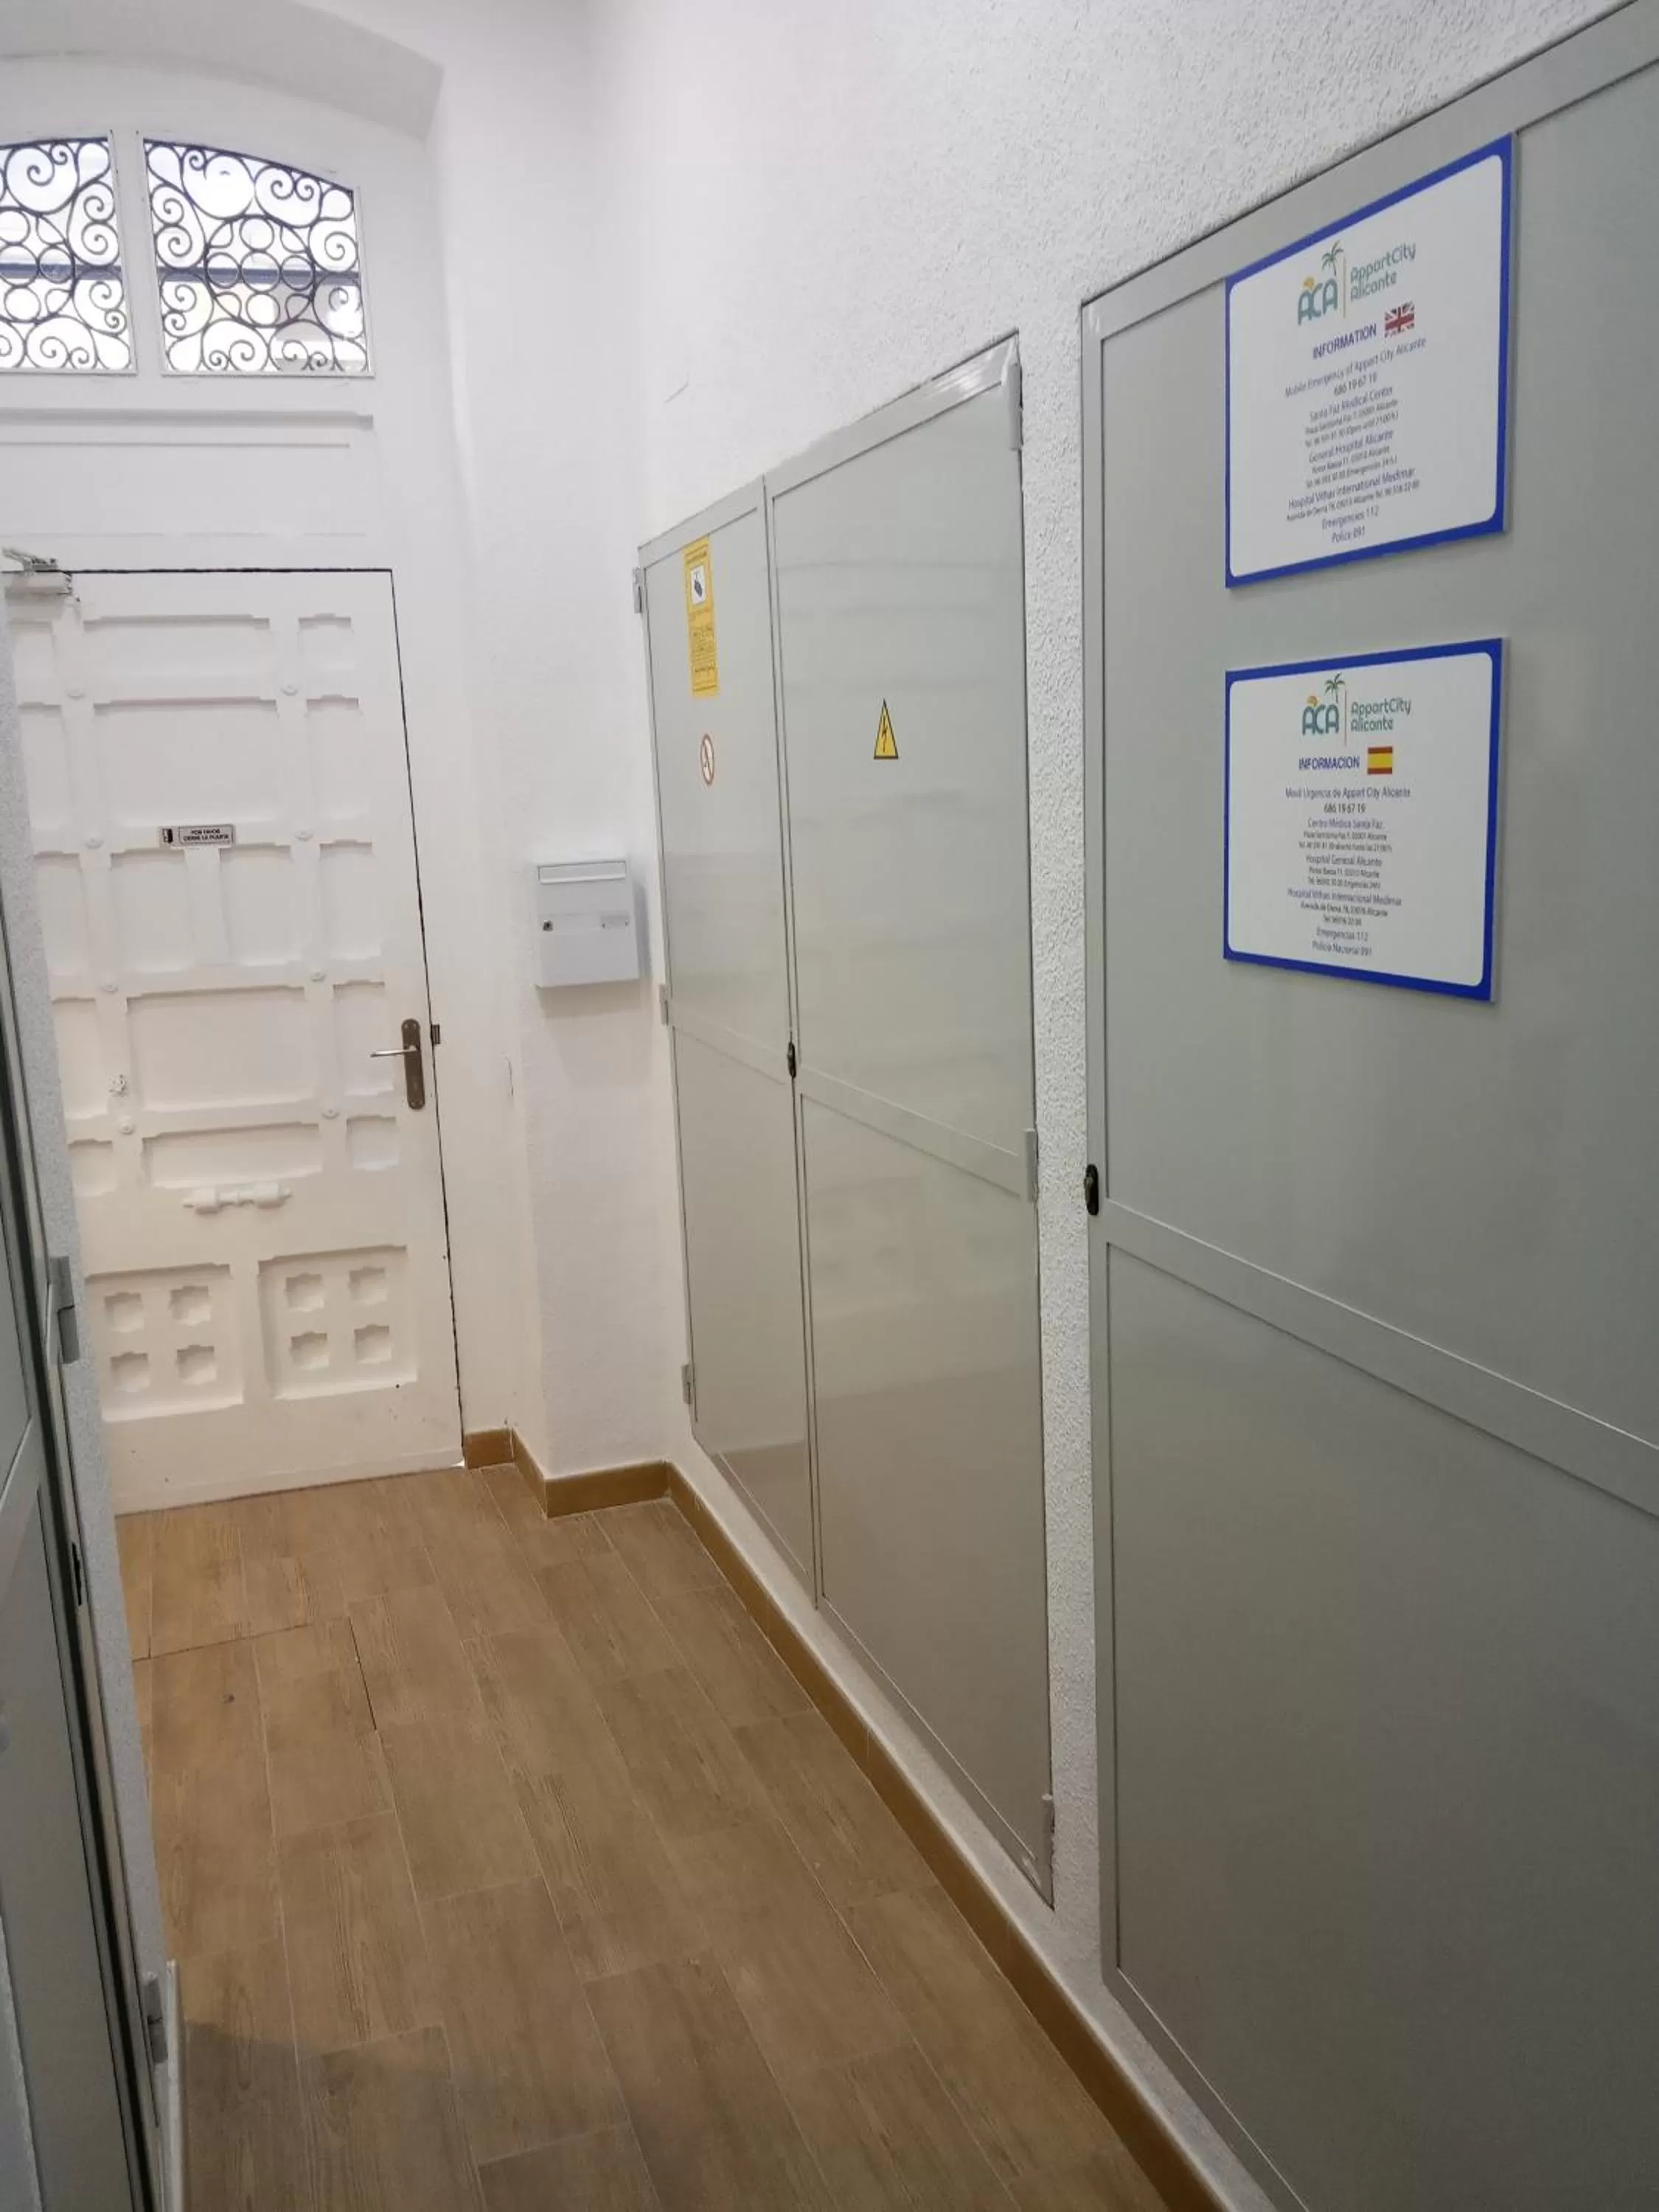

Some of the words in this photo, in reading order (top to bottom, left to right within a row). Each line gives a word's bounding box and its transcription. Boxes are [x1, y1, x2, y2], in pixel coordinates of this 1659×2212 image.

[1350, 243, 1416, 283] AppartCity
[1350, 271, 1397, 302] Alicante
[1298, 278, 1338, 325] ACA
[1312, 323, 1377, 359] INFORMATION
[1354, 354, 1379, 372] Appart
[1380, 349, 1394, 362] City
[1396, 338, 1427, 355] Alicante
[1341, 392, 1367, 410] Medical
[1369, 386, 1393, 401] Center
[1309, 448, 1334, 463] General
[1335, 437, 1363, 454] Hospital
[1365, 430, 1394, 445] Alicante
[1289, 494, 1315, 510] Hospital
[1336, 477, 1381, 495] International
[1322, 512, 1364, 529] Emergencies
[1332, 530, 1352, 543] Police
[1351, 697, 1412, 717] AppartCity
[1301, 704, 1340, 736] ACA
[1350, 717, 1394, 732] Alicante
[1332, 787, 1341, 798] de
[1342, 787, 1366, 800] Appart
[1366, 787, 1380, 800] City
[1382, 786, 1411, 799] Alicante
[1307, 818, 1328, 829] Centro
[1307, 855, 1330, 866] Hospital
[1331, 855, 1355, 865] General
[1357, 855, 1382, 867] Alicante
[1331, 891, 1372, 904] Internacional
[1332, 943, 1360, 955] Nacional
